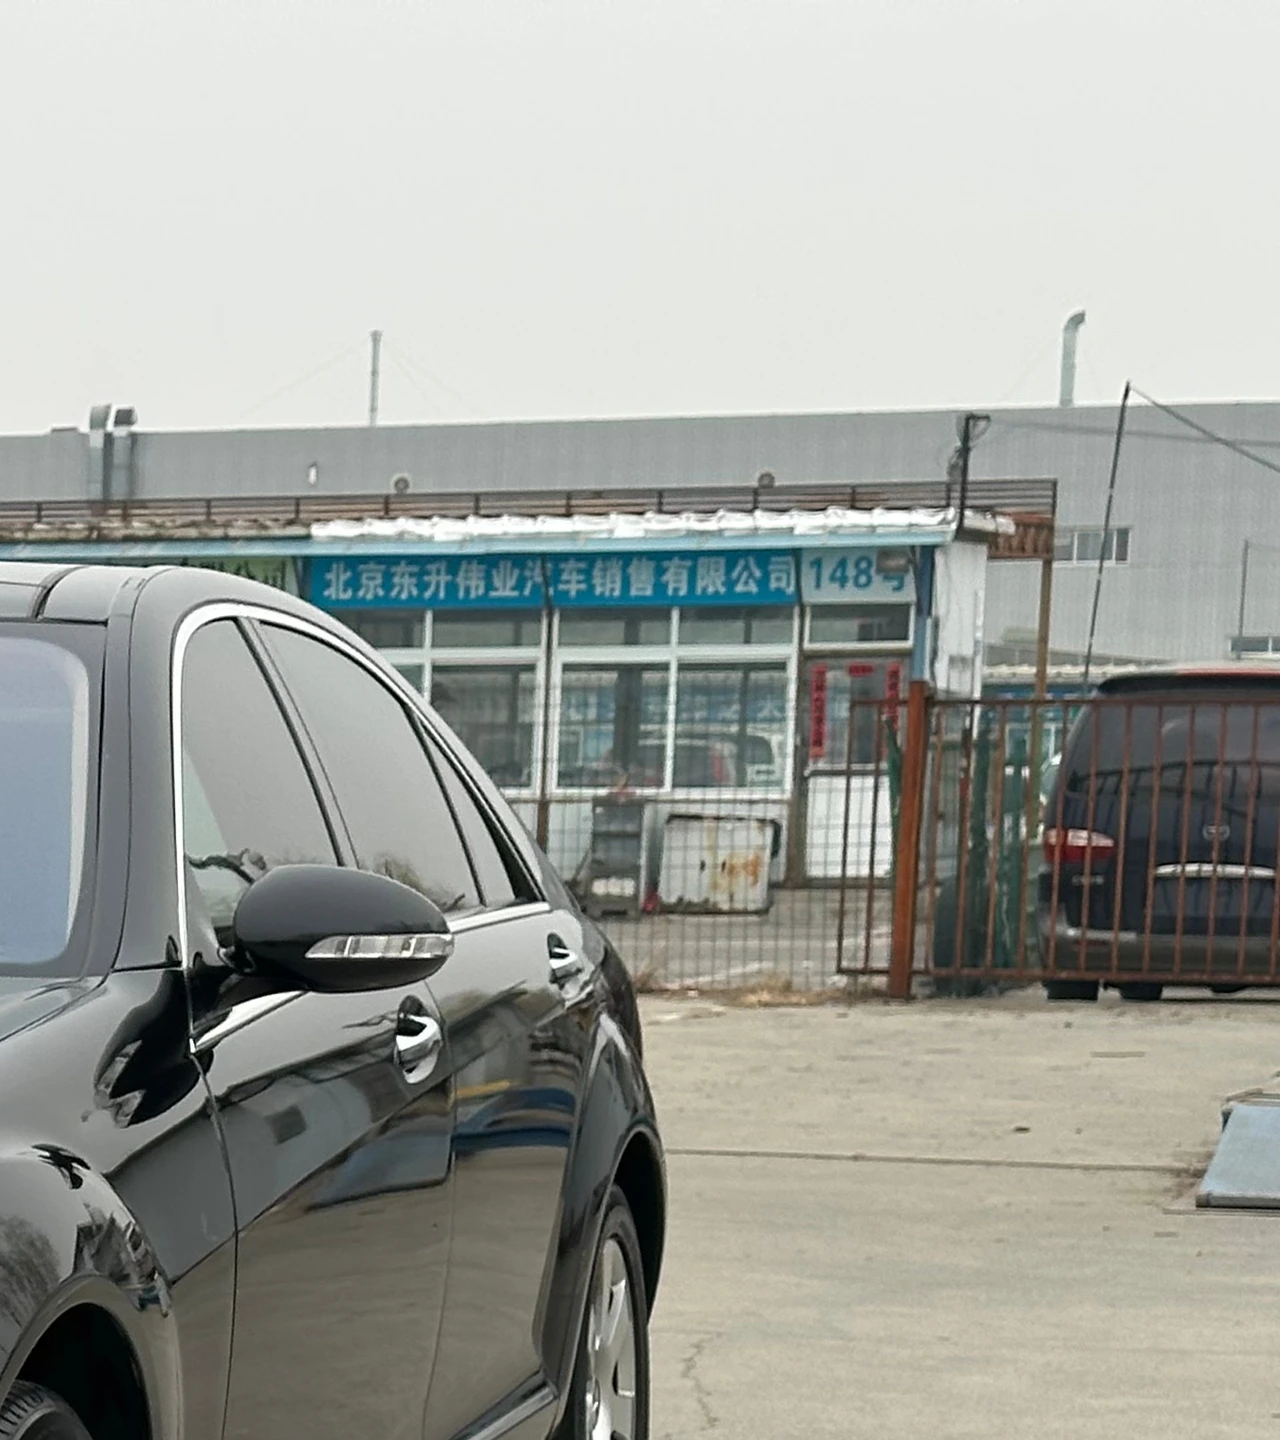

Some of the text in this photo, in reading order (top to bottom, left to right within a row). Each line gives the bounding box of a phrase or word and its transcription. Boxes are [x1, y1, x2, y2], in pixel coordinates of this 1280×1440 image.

[323, 556, 795, 600] 北京东升伟业汽车销售有限公司
